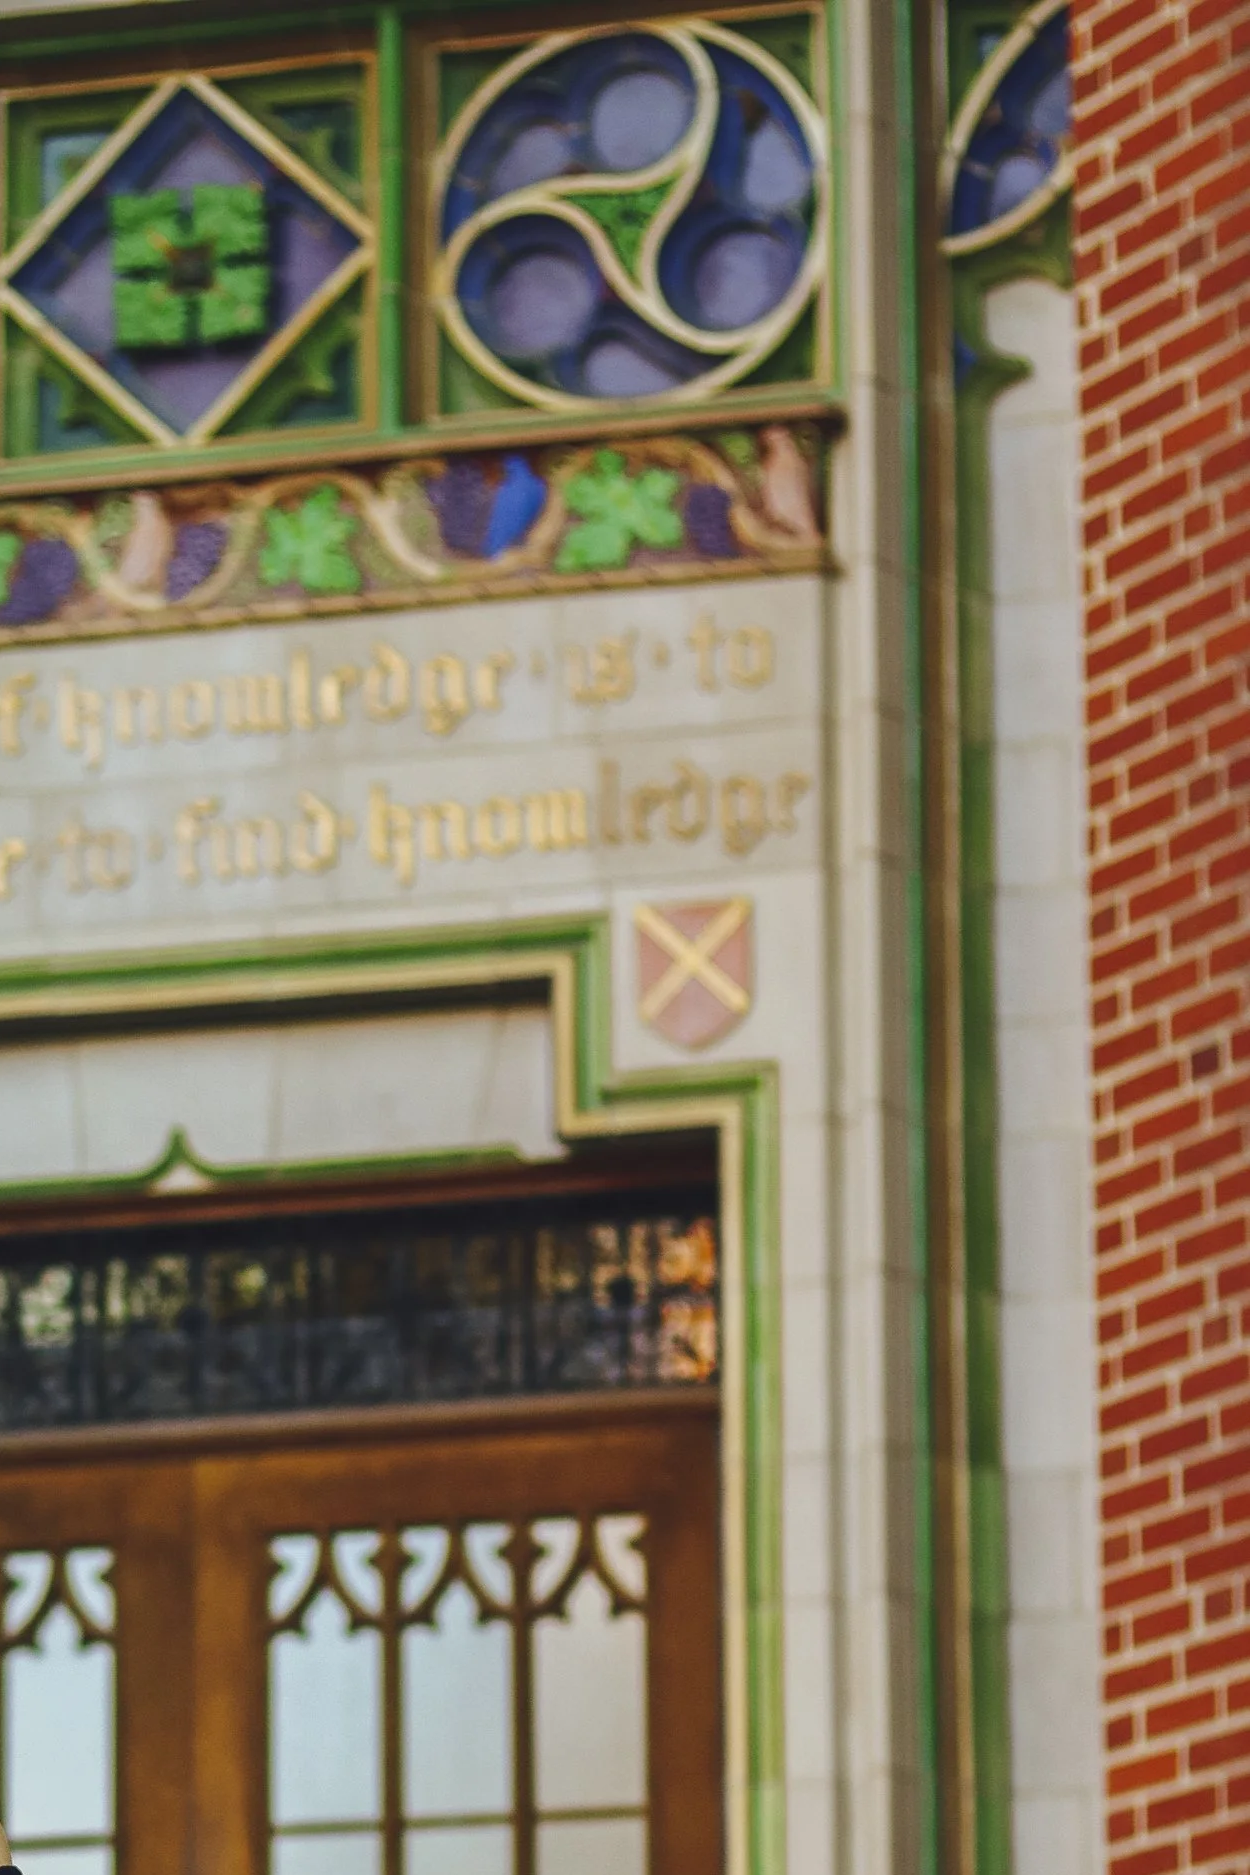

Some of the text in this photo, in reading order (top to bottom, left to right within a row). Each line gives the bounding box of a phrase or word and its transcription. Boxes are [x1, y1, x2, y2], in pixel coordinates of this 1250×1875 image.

[686, 612, 775, 692] to
[58, 818, 133, 893] to
[175, 792, 342, 884] find
